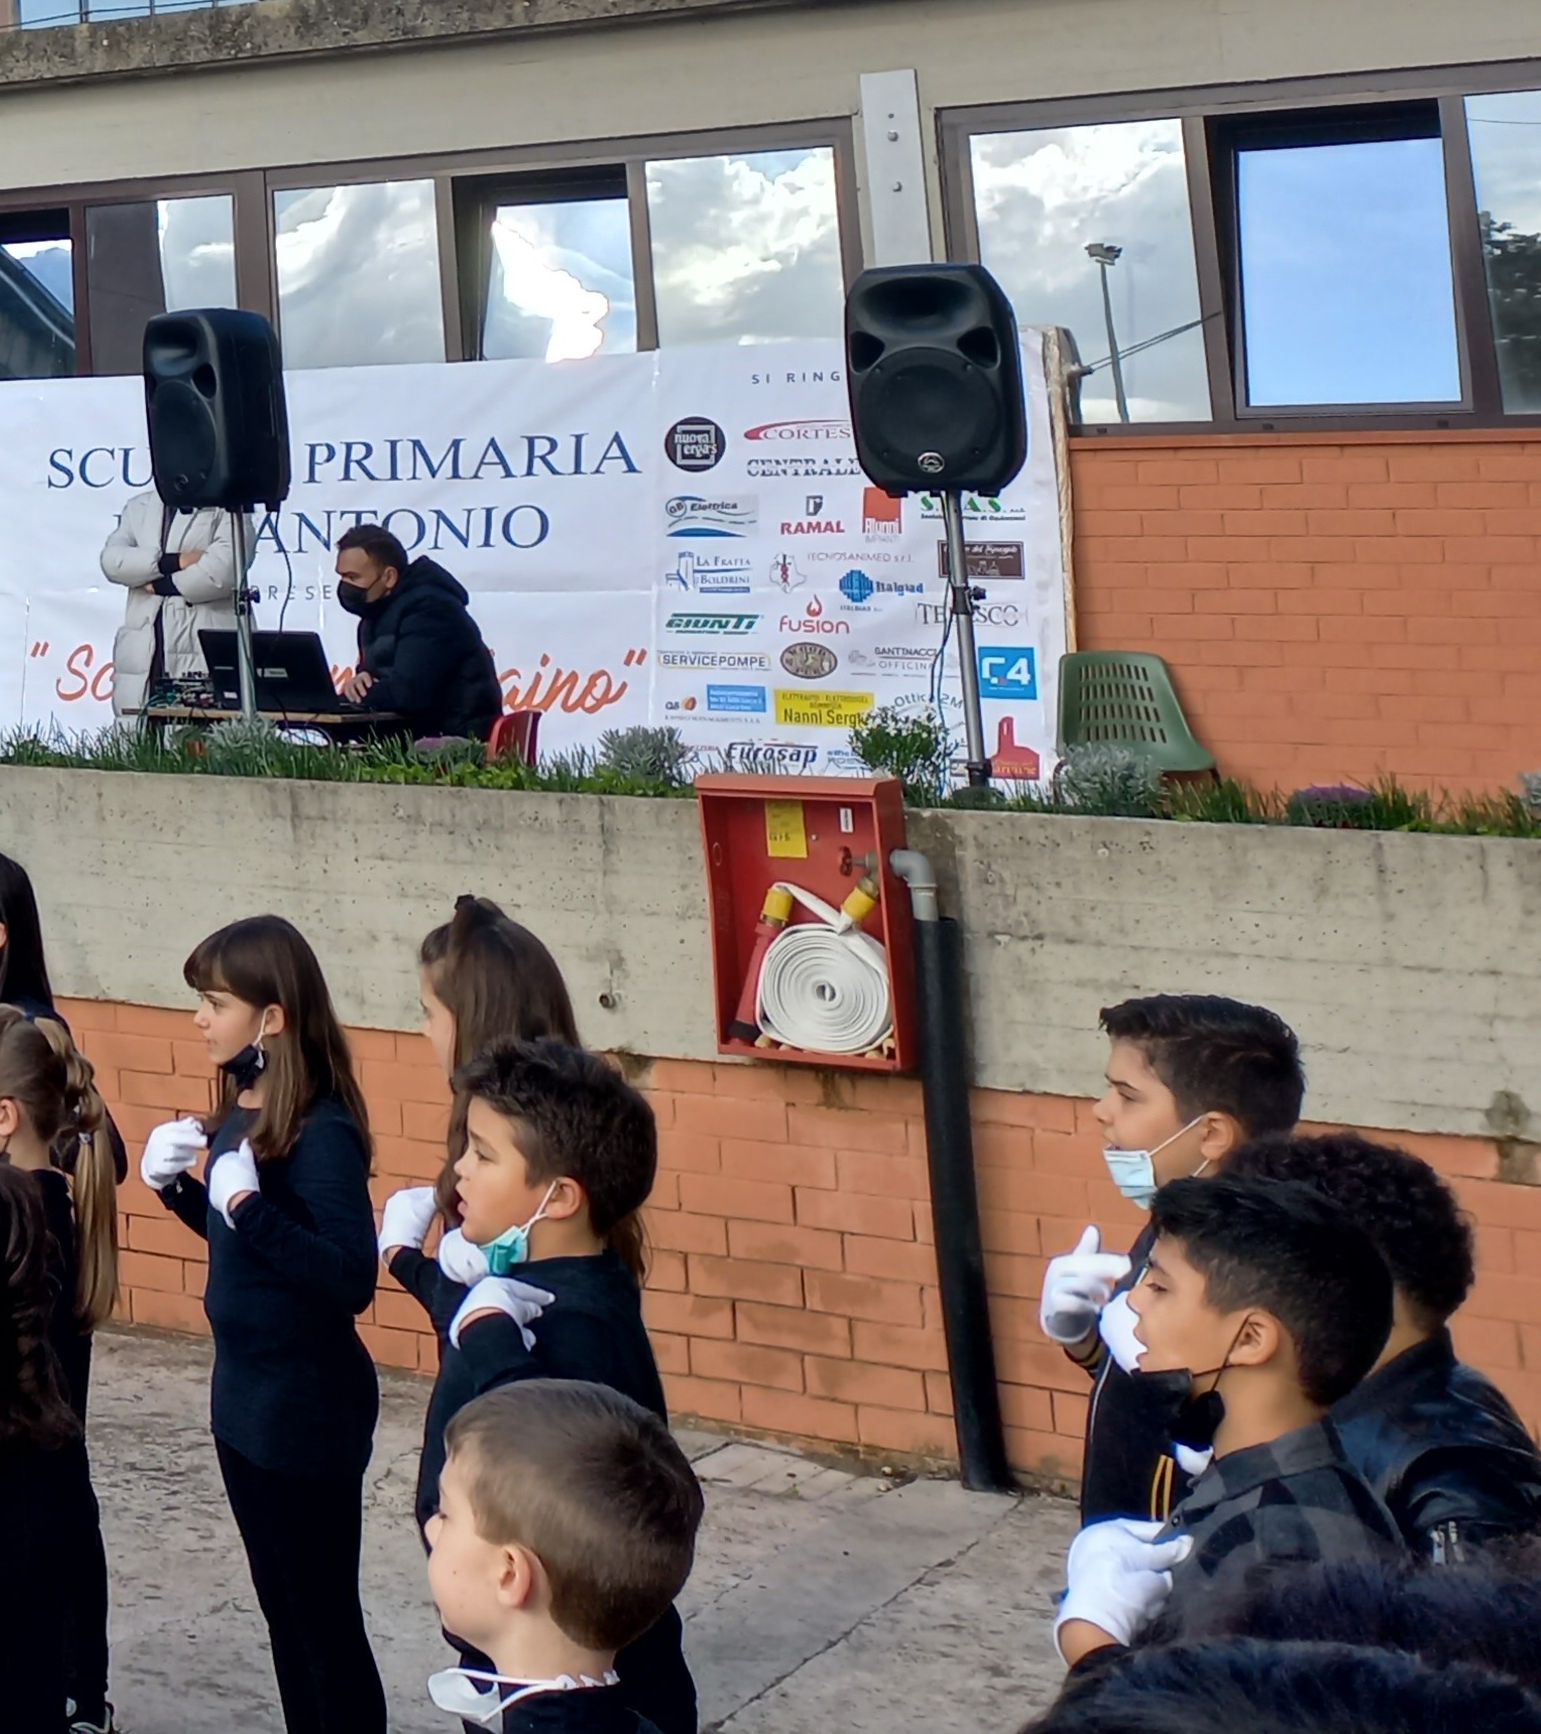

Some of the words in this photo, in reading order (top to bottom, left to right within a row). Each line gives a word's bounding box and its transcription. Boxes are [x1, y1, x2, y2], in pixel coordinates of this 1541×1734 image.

[751, 373, 770, 385] SI
[786, 371, 841, 383] RING
[762, 427, 851, 440] CORTES
[47, 447, 154, 489] SCU
[303, 430, 643, 484] PRIMARIA
[780, 520, 845, 536] RAMAL
[917, 604, 1019, 628] TESCO
[779, 615, 851, 635] fusion
[878, 660, 934, 670] OFFICIN
[894, 692, 927, 708] Ottic
[783, 708, 823, 724] Nanni
[826, 709, 870, 729] Sergi
